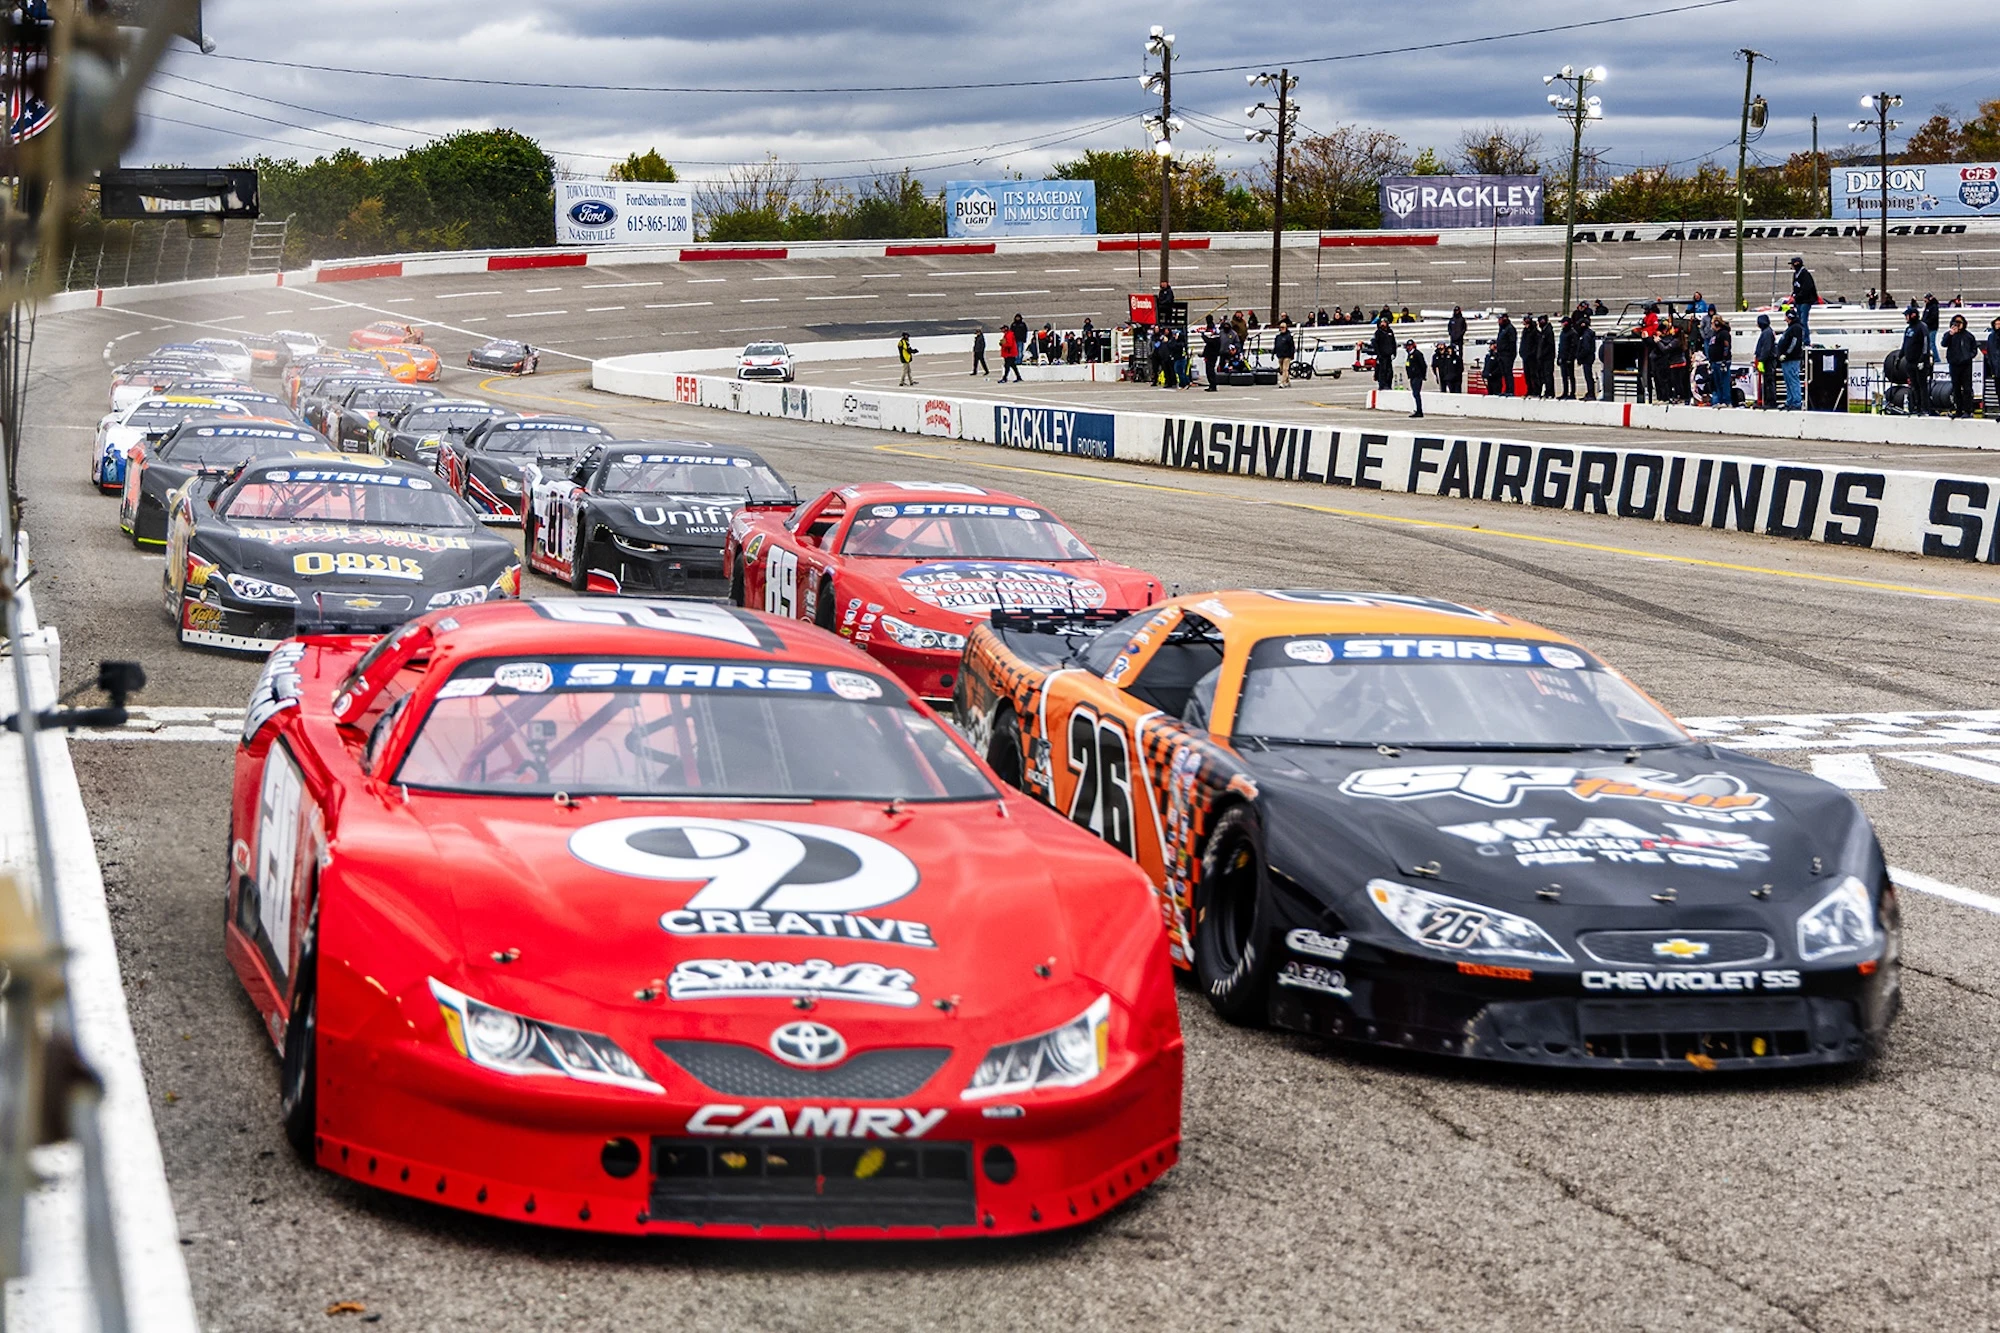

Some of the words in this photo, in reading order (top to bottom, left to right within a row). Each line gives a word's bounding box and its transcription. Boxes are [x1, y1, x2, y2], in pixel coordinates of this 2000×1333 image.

[1965, 169, 1992, 180] CJ'S
[566, 185, 585, 200] TOWN
[590, 185, 617, 200] COUNTRY
[625, 193, 682, 207] FordNashville.com
[1003, 191, 1025, 206] IT'S
[1027, 190, 1083, 206] RACEDAY
[1421, 185, 1541, 208] RACKLEY
[139, 194, 221, 213] WHELEN
[578, 203, 607, 222] Ford
[955, 201, 997, 217] BUSCH
[1003, 207, 1018, 221] IN
[1020, 206, 1062, 221] MUSIC
[1062, 205, 1090, 221] CITY
[627, 215, 683, 232] 615-865-1280
[965, 216, 989, 225] LIGHT
[568, 227, 616, 241] NASHVILLE
[1574, 229, 1642, 243] ALL
[1656, 225, 1869, 242] AMERICAN
[1888, 224, 1967, 236] 400
[676, 375, 698, 404] ASA
[166, 401, 222, 411] STARS
[437, 406, 489, 414] STARS
[218, 427, 295, 439] STARS
[522, 423, 584, 432] STARS
[1000, 406, 1076, 453] RACKLEY
[1077, 437, 1108, 458] ROOFING
[646, 455, 728, 466] STARS
[295, 470, 402, 486] STARS
[1160, 417, 1389, 490] NASHVILLE
[1407, 436, 1887, 549] FAIRGROUNDS
[1922, 478, 2000, 564] S
[633, 506, 732, 526] Unifi
[902, 503, 1011, 518] STARS
[237, 526, 349, 541] MITCH
[359, 526, 471, 550] SMITH
[293, 552, 424, 576] OASIS
[905, 571, 962, 586] US
[971, 569, 1082, 588] TANK
[940, 579, 1100, 600] CRYOGENIC
[934, 589, 1094, 610] EQUIPMENT
[1342, 638, 1533, 662] STARS
[566, 662, 813, 692] STARS
[1064, 706, 1136, 862] 26
[1660, 804, 1776, 824] USA
[1511, 838, 1641, 852] SHOCKS
[1514, 850, 1597, 867] FEEL
[1597, 849, 1666, 864] THE
[659, 909, 937, 947] CREATIVE
[1415, 906, 1490, 950] 26
[1580, 970, 1759, 991] CHEVROLET
[1761, 970, 1801, 989] SS
[684, 1103, 949, 1138] CAMRY
